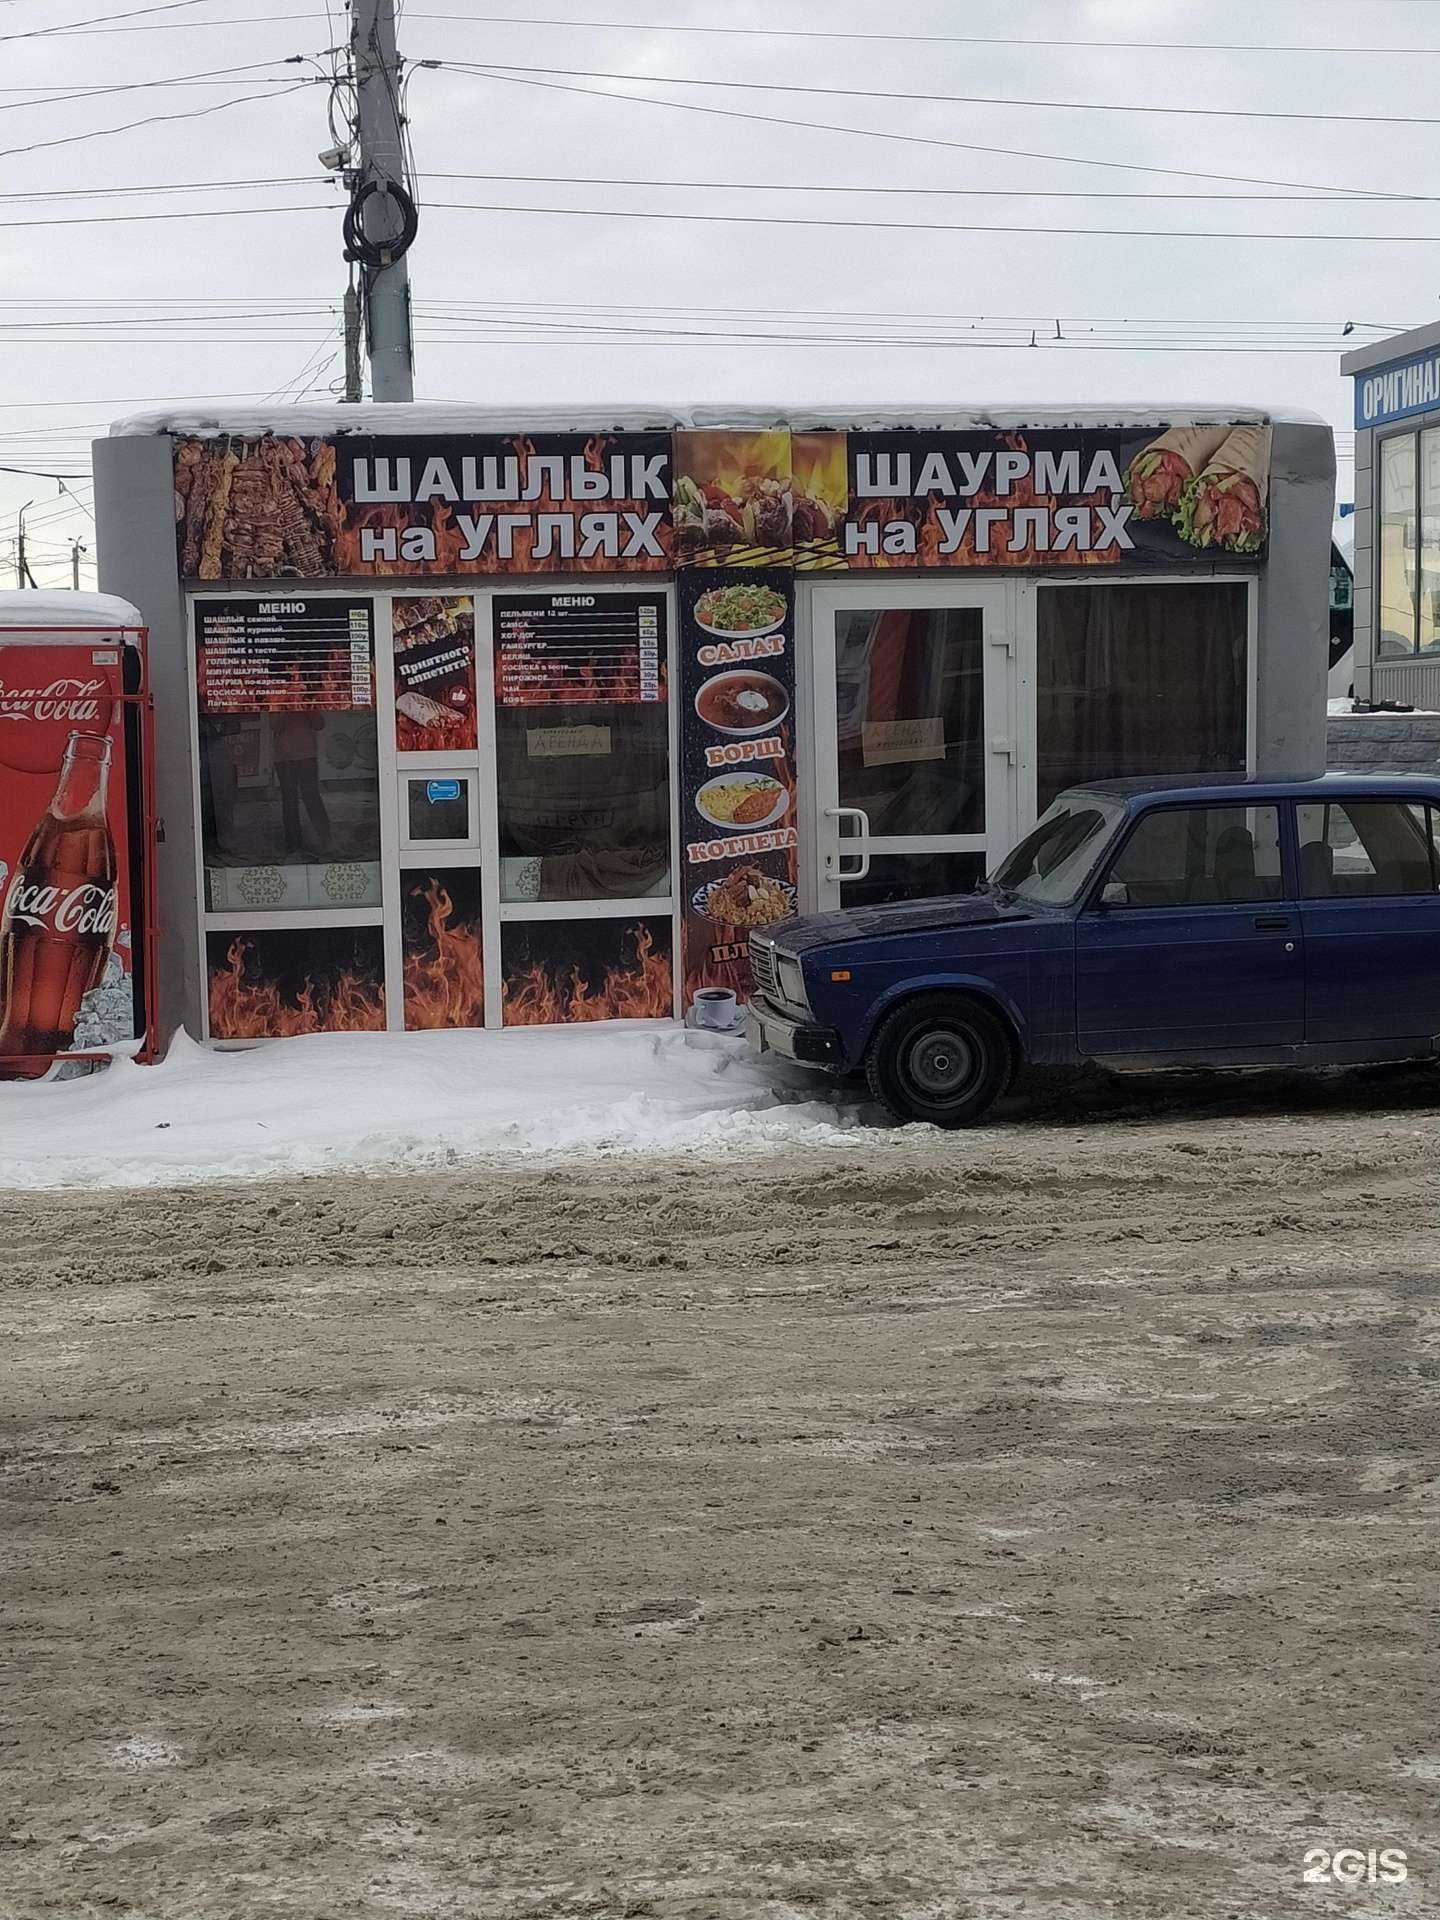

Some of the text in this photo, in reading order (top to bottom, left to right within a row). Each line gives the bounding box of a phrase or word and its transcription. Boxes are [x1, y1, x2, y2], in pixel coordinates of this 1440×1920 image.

[353, 454, 669, 503] ШАШЛЫК
[855, 450, 1126, 497] ШАУРМА
[360, 512, 666, 562] на УГЛЯХ
[845, 506, 1136, 555] на УГЛЯХ
[259, 603, 306, 614] МЕНЮ
[552, 596, 595, 607] МЕНЮ
[399, 646, 470, 675] Приятного
[697, 634, 785, 666] САЛАТ
[407, 656, 471, 685] аппетита!
[705, 737, 785, 767] БОРЩ
[687, 827, 797, 863] КОТЛЕТА
[6, 875, 115, 933] Coca-Cola
[711, 942, 750, 962] ПЛ
